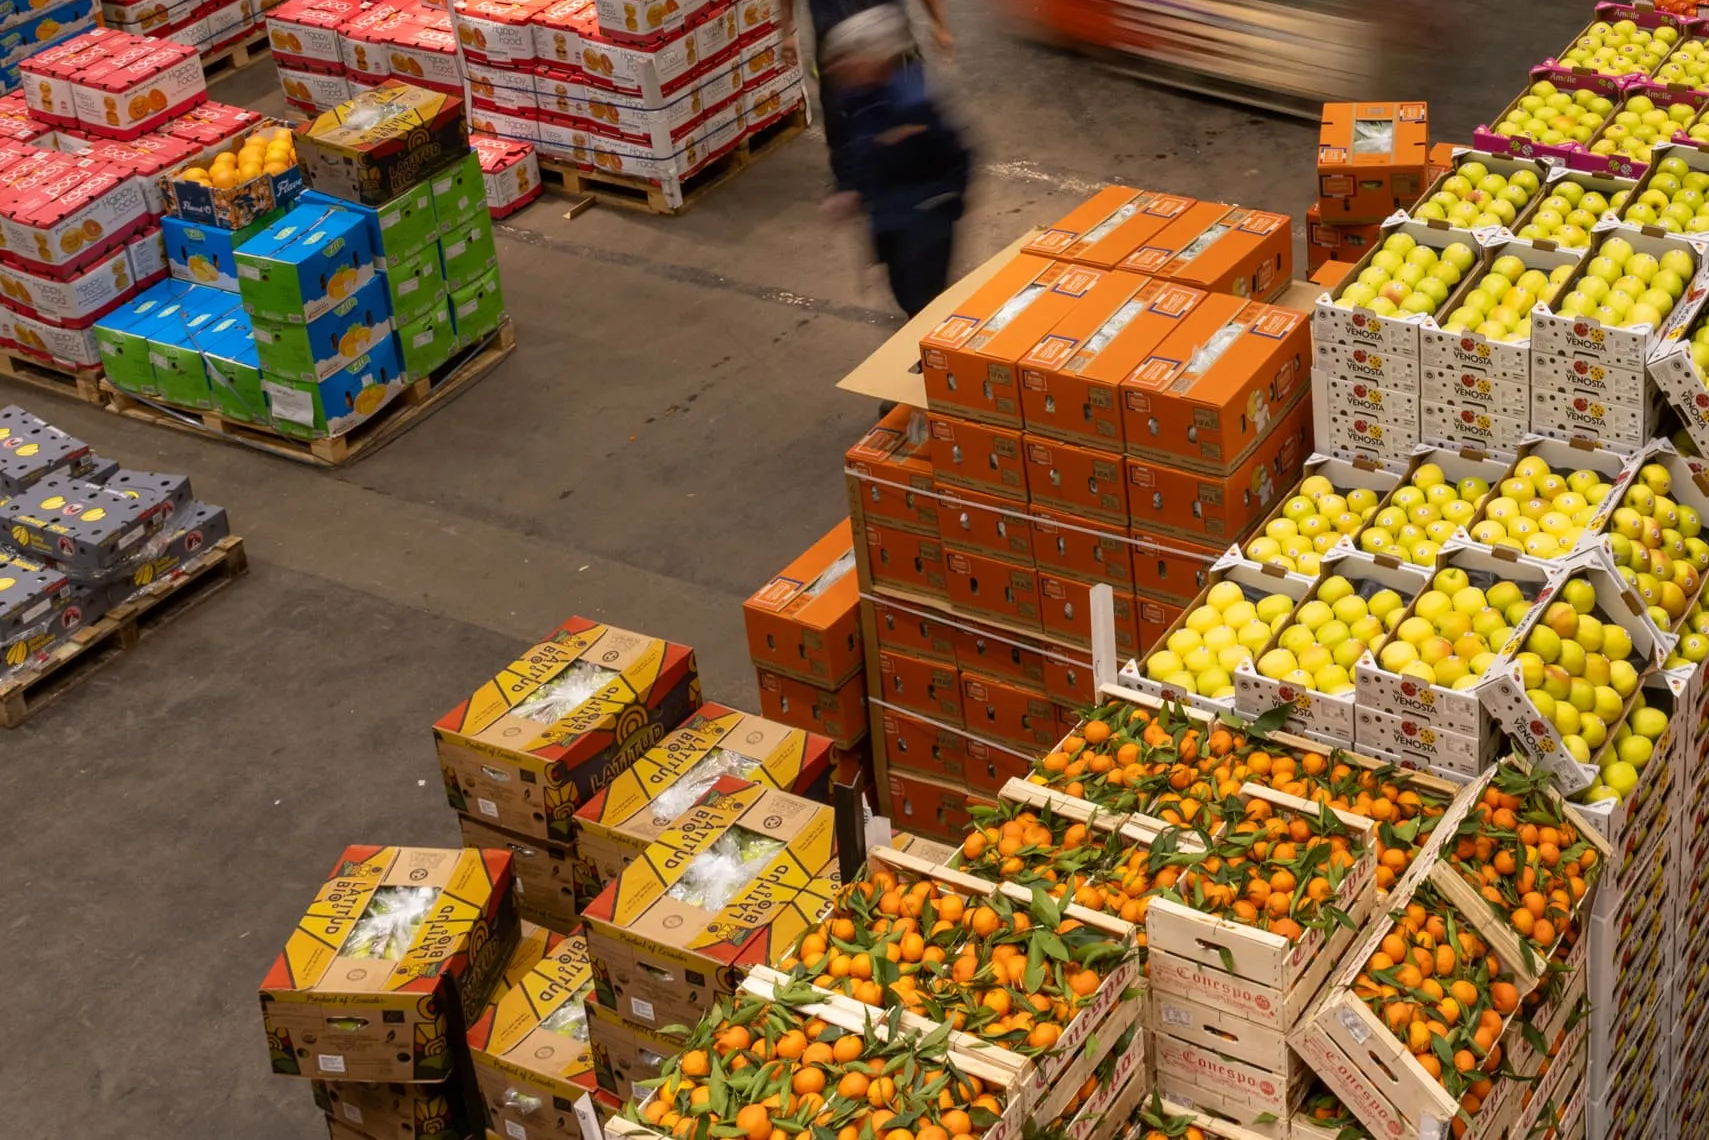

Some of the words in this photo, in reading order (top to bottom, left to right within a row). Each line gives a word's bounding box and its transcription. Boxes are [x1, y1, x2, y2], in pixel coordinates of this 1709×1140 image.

[304, 29, 333, 43] Happy
[312, 39, 337, 50] Food
[167, 60, 196, 81] Happy
[177, 67, 201, 87] Food
[103, 184, 134, 206] Happy
[113, 192, 139, 212] Food
[1345, 326, 1384, 342] VENOSTA
[1565, 336, 1607, 352] VENOSTA
[1453, 350, 1493, 366] VENOSTA
[1346, 361, 1384, 377] VENOSTA
[1565, 373, 1607, 390] VENOSTA
[1346, 396, 1385, 412] VENOSTA
[1454, 386, 1494, 402] VENOSTA
[1565, 411, 1607, 427] VENOSTA
[1680, 392, 1707, 431] VENOSTA
[1347, 431, 1386, 447] VENOSTA
[1454, 422, 1494, 438] VENOSTA
[511, 649, 569, 693] LATITUD
[561, 686, 619, 729] LATITUD
[1393, 696, 1438, 715] VENOSTA
[1393, 735, 1439, 754] VENOSTA
[1513, 717, 1546, 760] VENOSTA
[590, 722, 664, 793] LATITUD
[650, 737, 706, 784] LATITUD
[665, 813, 724, 869] LATITUD
[730, 865, 789, 920] LATITUD
[325, 881, 367, 934] LATITUD
[414, 905, 454, 959] LATITUD
[539, 945, 591, 1002] ATITUD
[1177, 966, 1251, 1002] Conespo
[306, 993, 338, 1004] Product
[340, 994, 348, 1005] of
[1182, 1048, 1256, 1087] Conespo
[1324, 1049, 1389, 1126] Conespo
